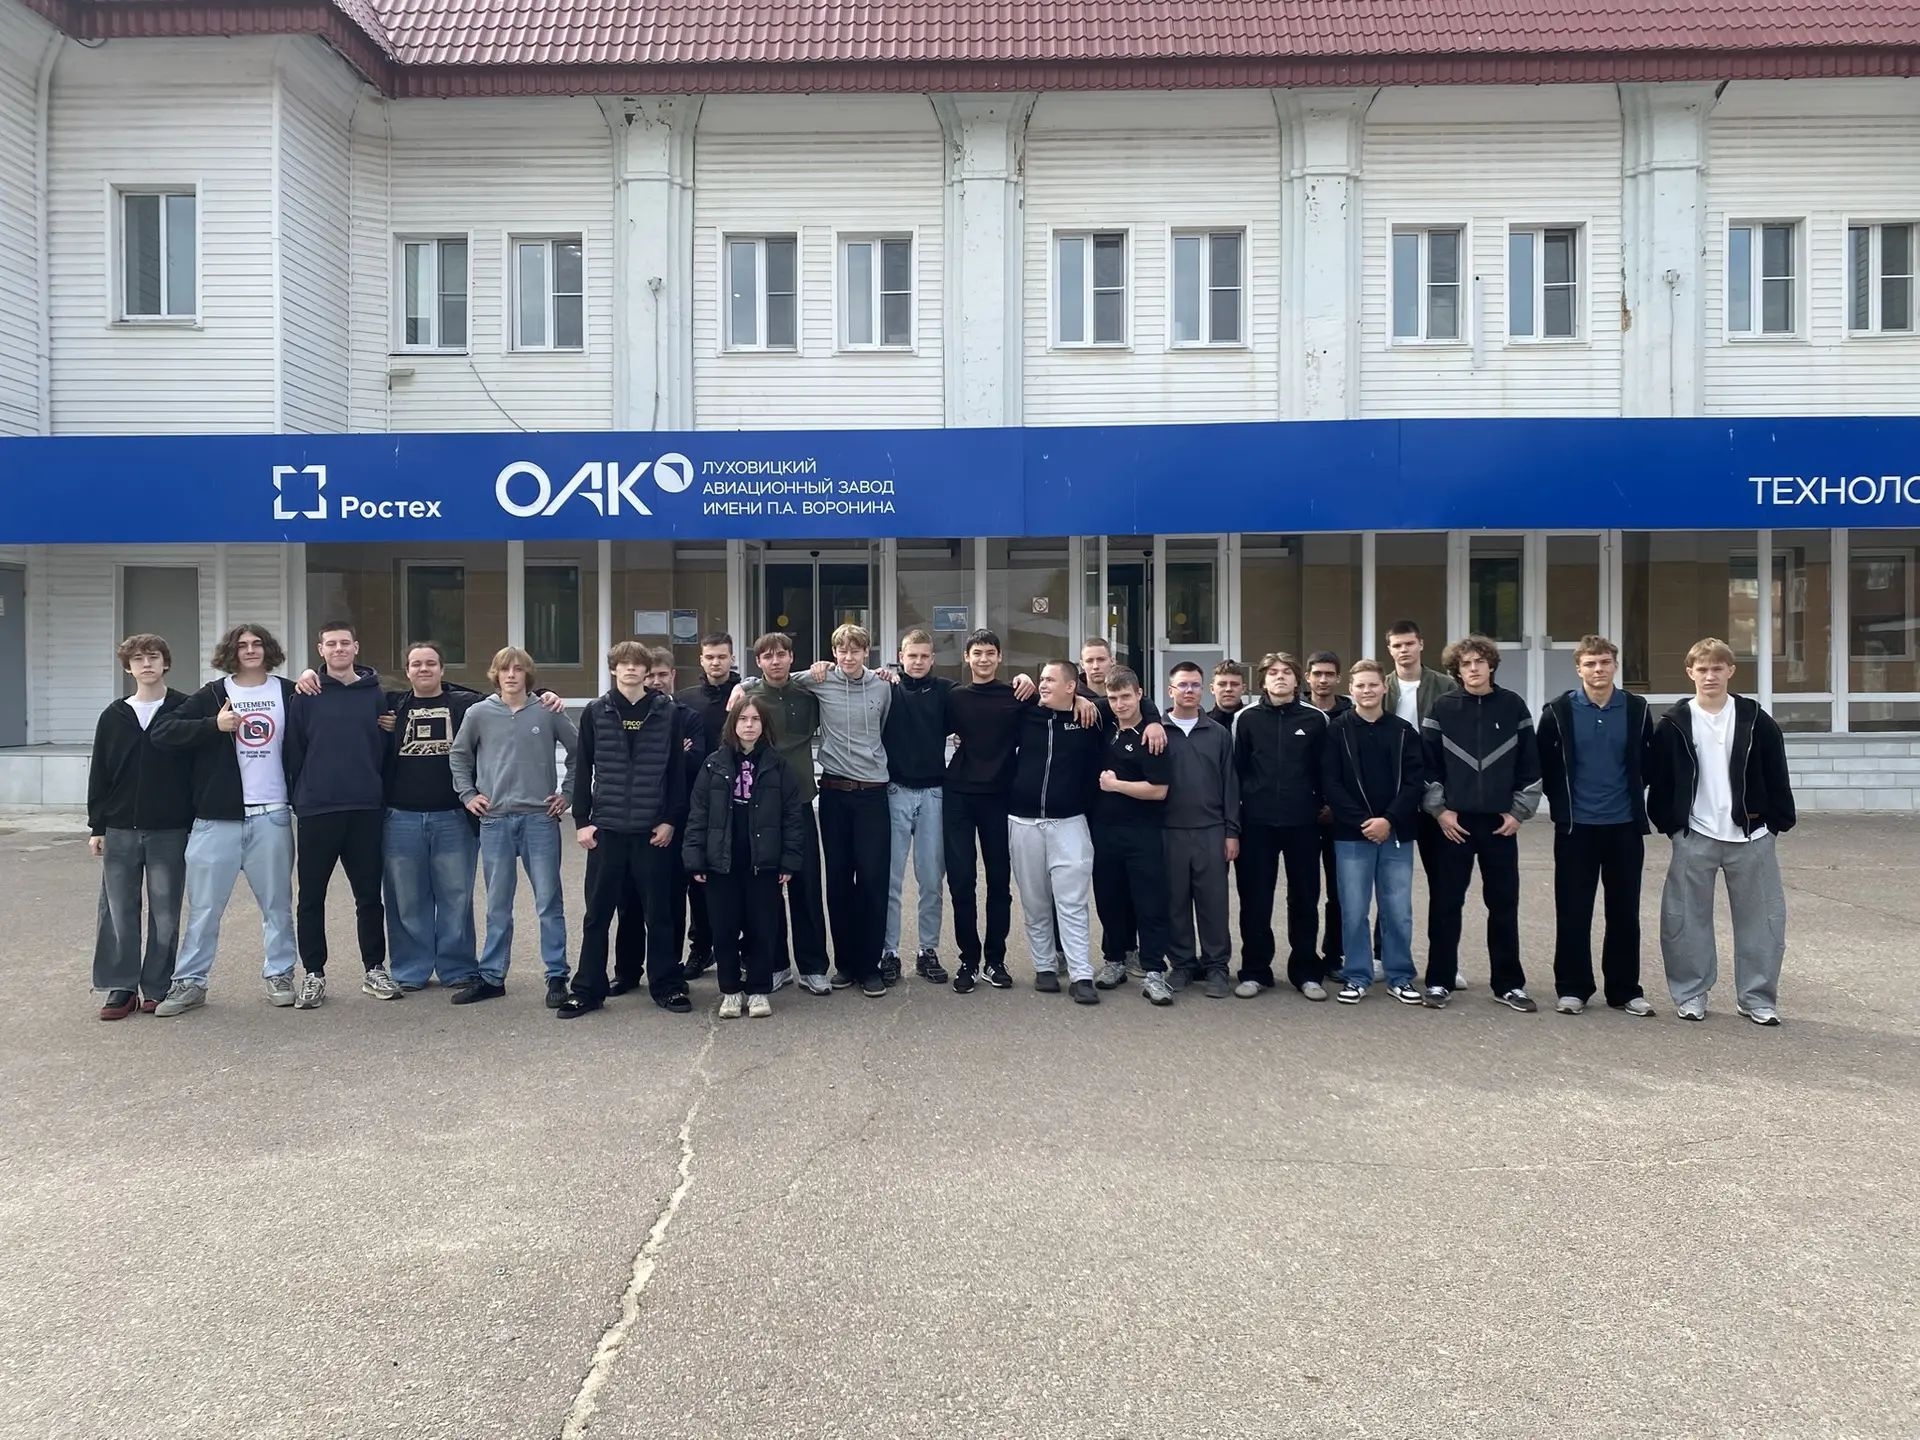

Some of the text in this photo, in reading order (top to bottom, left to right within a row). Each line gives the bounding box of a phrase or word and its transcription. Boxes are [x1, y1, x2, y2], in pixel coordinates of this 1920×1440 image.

[702, 458, 817, 475] ЛУХОВИЦКИЙ
[495, 461, 653, 517] ОАК
[703, 478, 895, 496] АВИАЦИОННЫЙ ЗАВОД
[341, 496, 442, 519] Ростех
[703, 500, 896, 515] ИМЕНИ П.А. ВОРОНИНА
[233, 701, 276, 709] VETEMENTS
